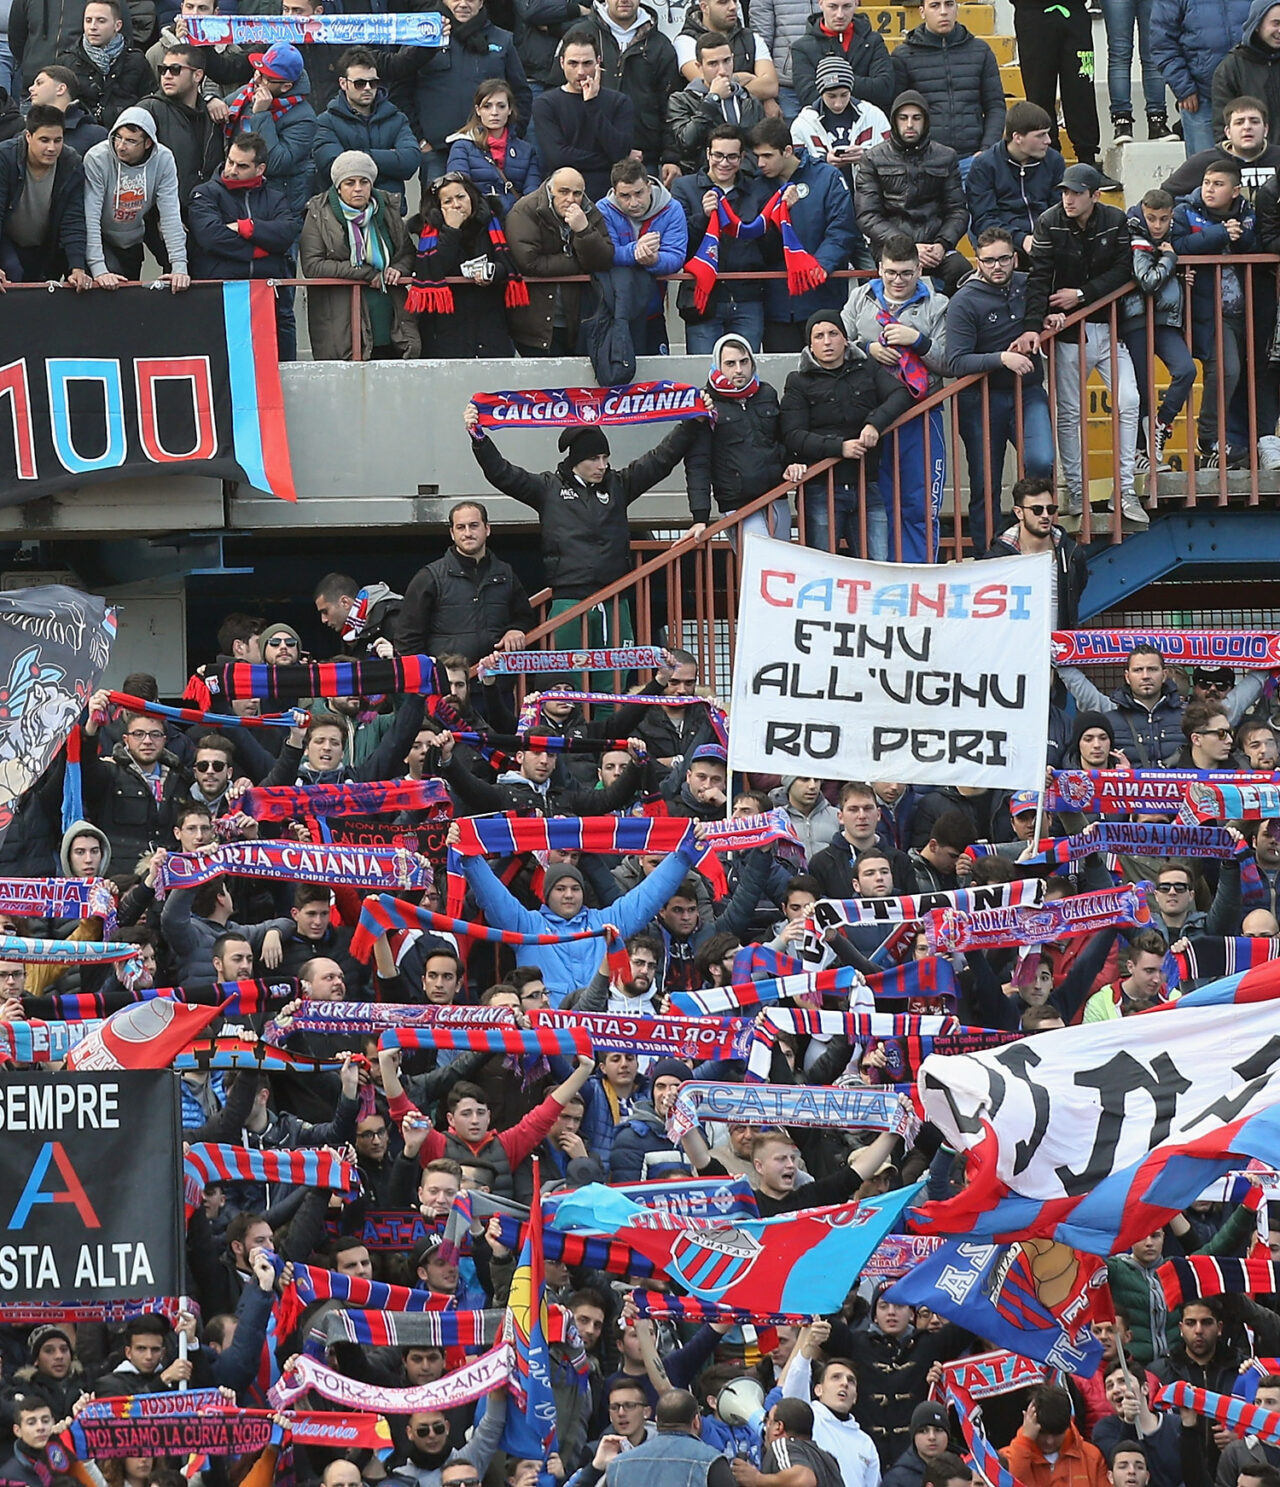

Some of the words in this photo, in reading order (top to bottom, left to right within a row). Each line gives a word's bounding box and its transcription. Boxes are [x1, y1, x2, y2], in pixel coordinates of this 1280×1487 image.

[492, 401, 570, 420] CALCIO
[604, 388, 696, 414] CATANIA
[760, 568, 1031, 620] CATANISI
[1074, 632, 1184, 656] PALERMO
[873, 727, 1008, 766] PERI
[345, 821, 374, 831] NON
[281, 847, 382, 877] CATANIA
[293, 872, 330, 882] SEMPRE
[971, 909, 1018, 931] FORZA
[1061, 894, 1120, 920] CATANIA
[308, 1001, 371, 1019] FORZA
[707, 1086, 889, 1122] CATANIA
[74, 1241, 155, 1287] ALTA
[312, 1368, 391, 1404] FORZA
[402, 1355, 513, 1404] CATANIA
[86, 1428, 114, 1448] NOI
[115, 1428, 160, 1448] SIAMO
[164, 1427, 181, 1446] LA
[183, 1425, 228, 1445] CURVA
[233, 1423, 271, 1443] NORD
